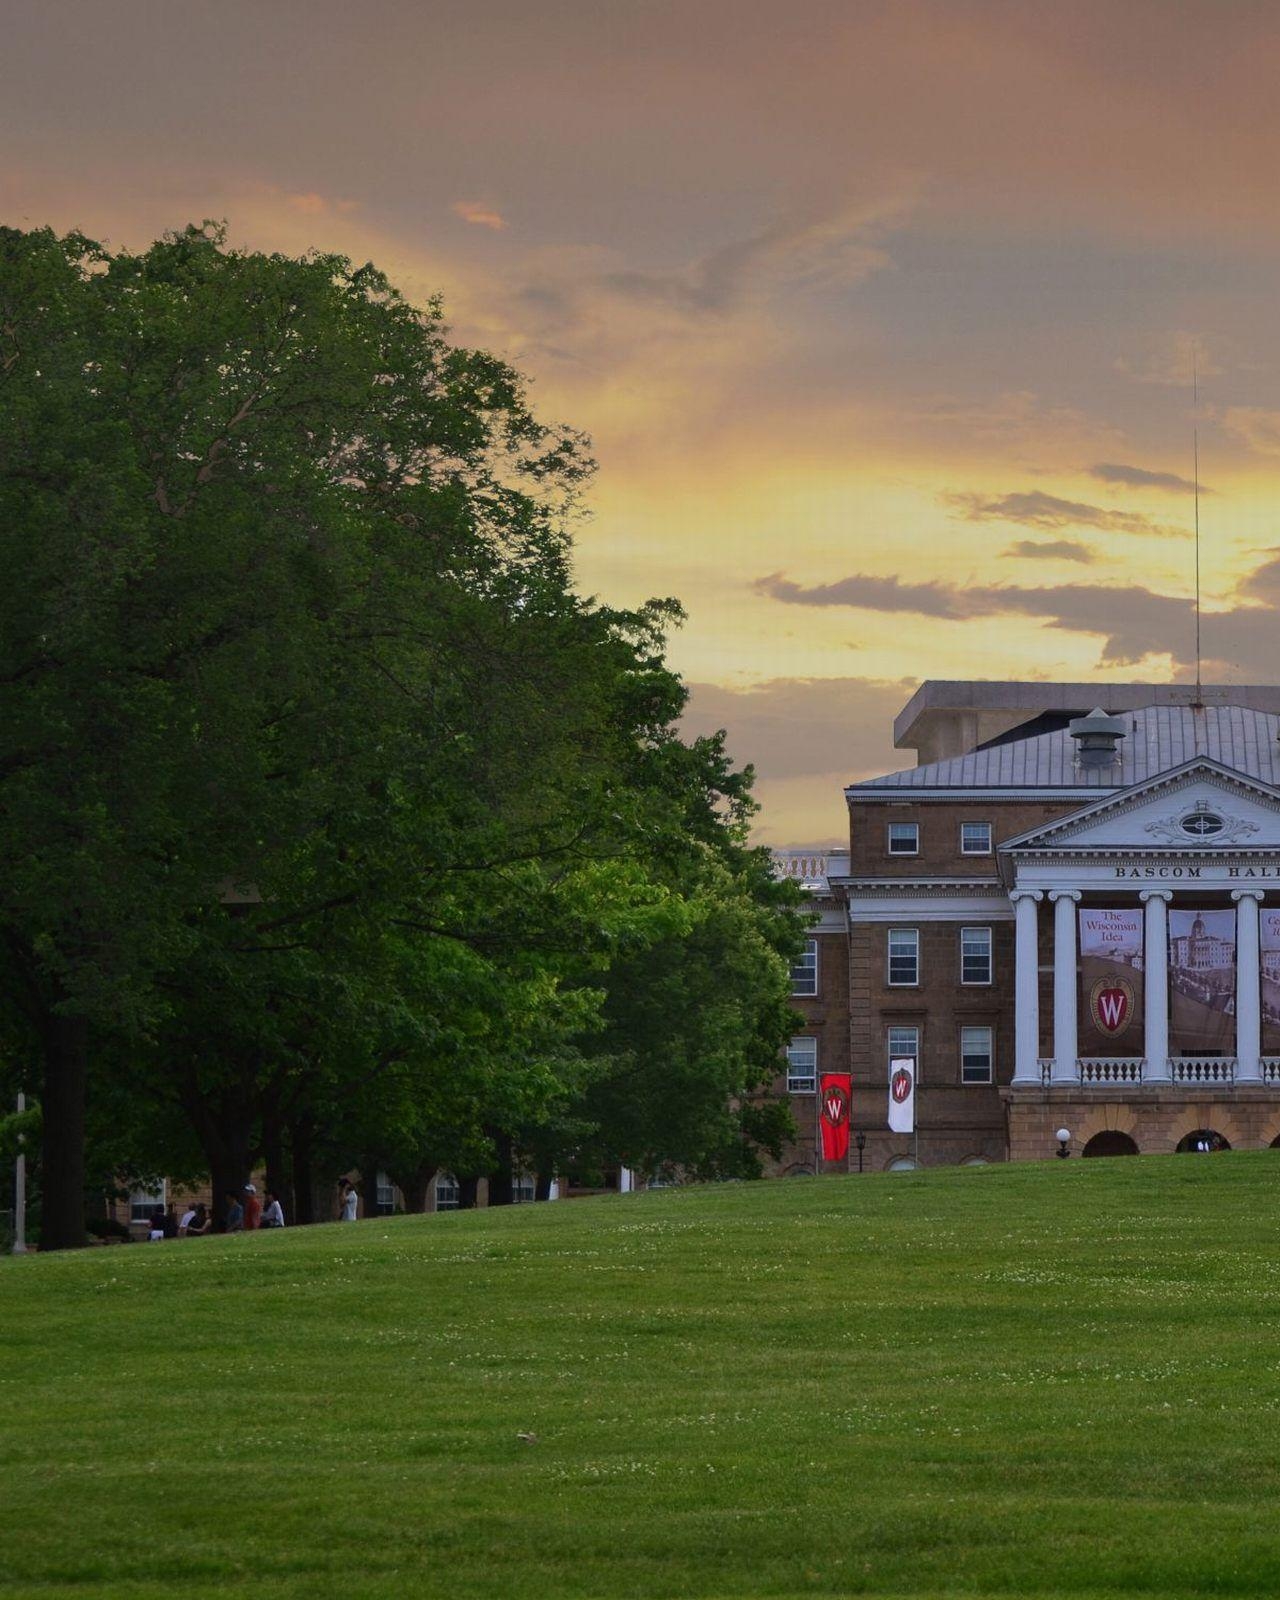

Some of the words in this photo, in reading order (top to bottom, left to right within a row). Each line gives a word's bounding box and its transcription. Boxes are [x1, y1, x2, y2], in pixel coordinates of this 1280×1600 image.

[1116, 867, 1201, 878] BASCOM
[1101, 911, 1122, 921] The
[1086, 920, 1137, 931] Wisconsin
[1102, 931, 1123, 942] Idea
[1100, 993, 1125, 1026] W
[895, 1079, 907, 1098] W
[827, 1098, 842, 1120] W
